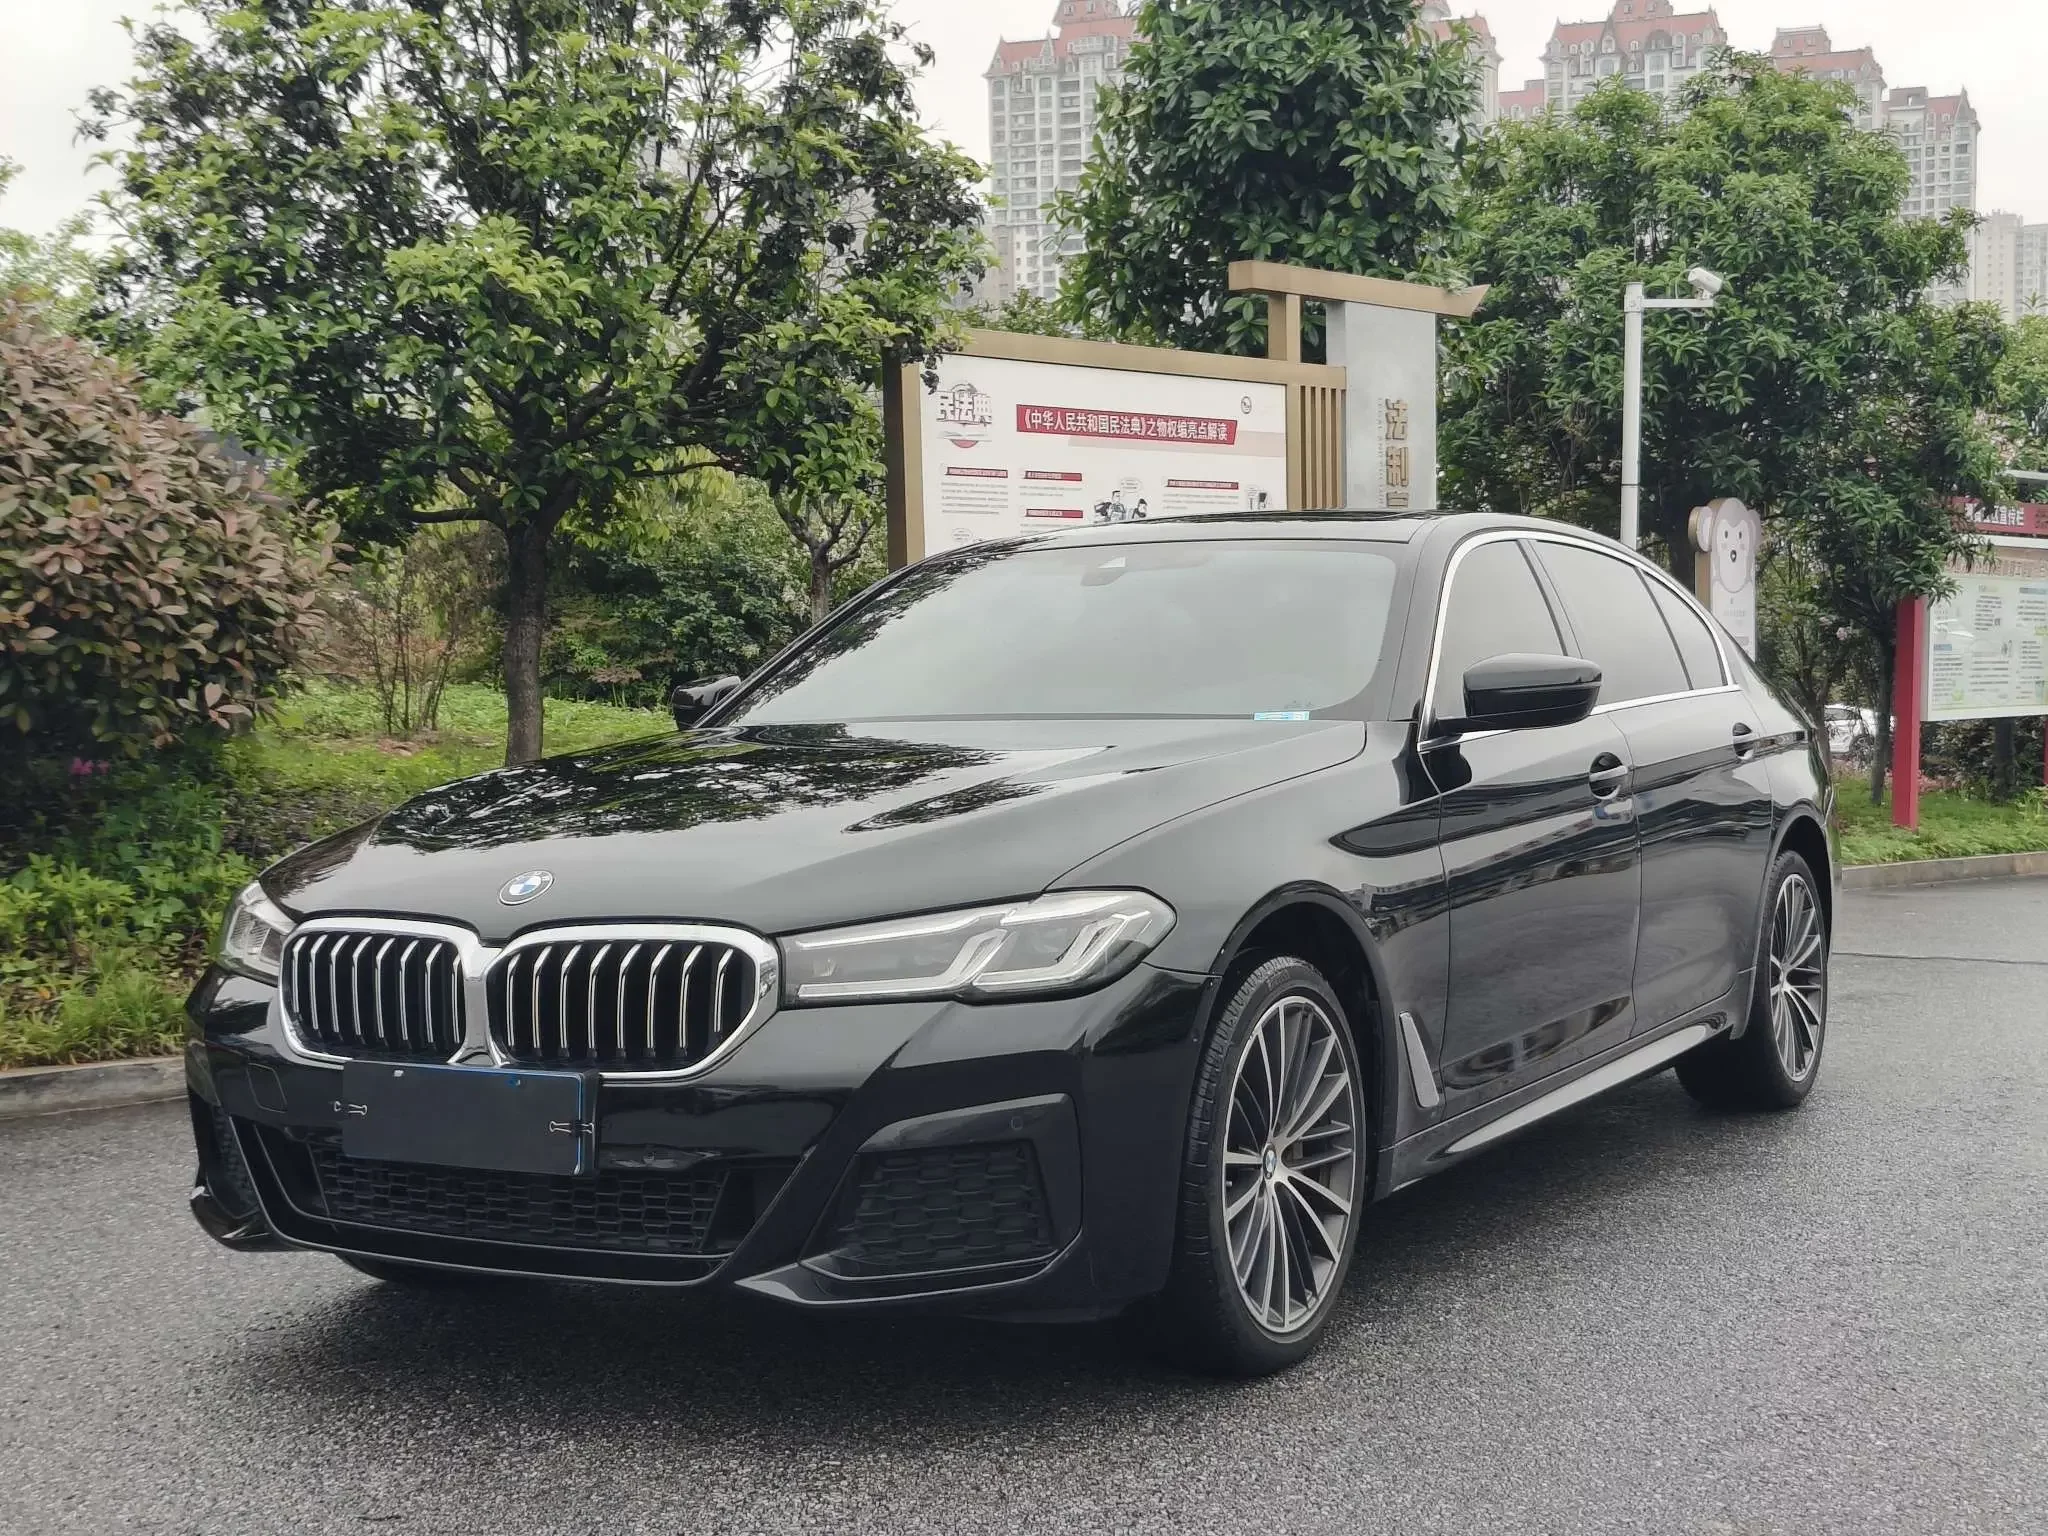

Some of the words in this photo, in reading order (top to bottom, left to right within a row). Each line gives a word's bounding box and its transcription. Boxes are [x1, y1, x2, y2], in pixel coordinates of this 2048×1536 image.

[1025, 408, 1227, 440] 《中华人民共和国民法典》之物权编亮点解读
